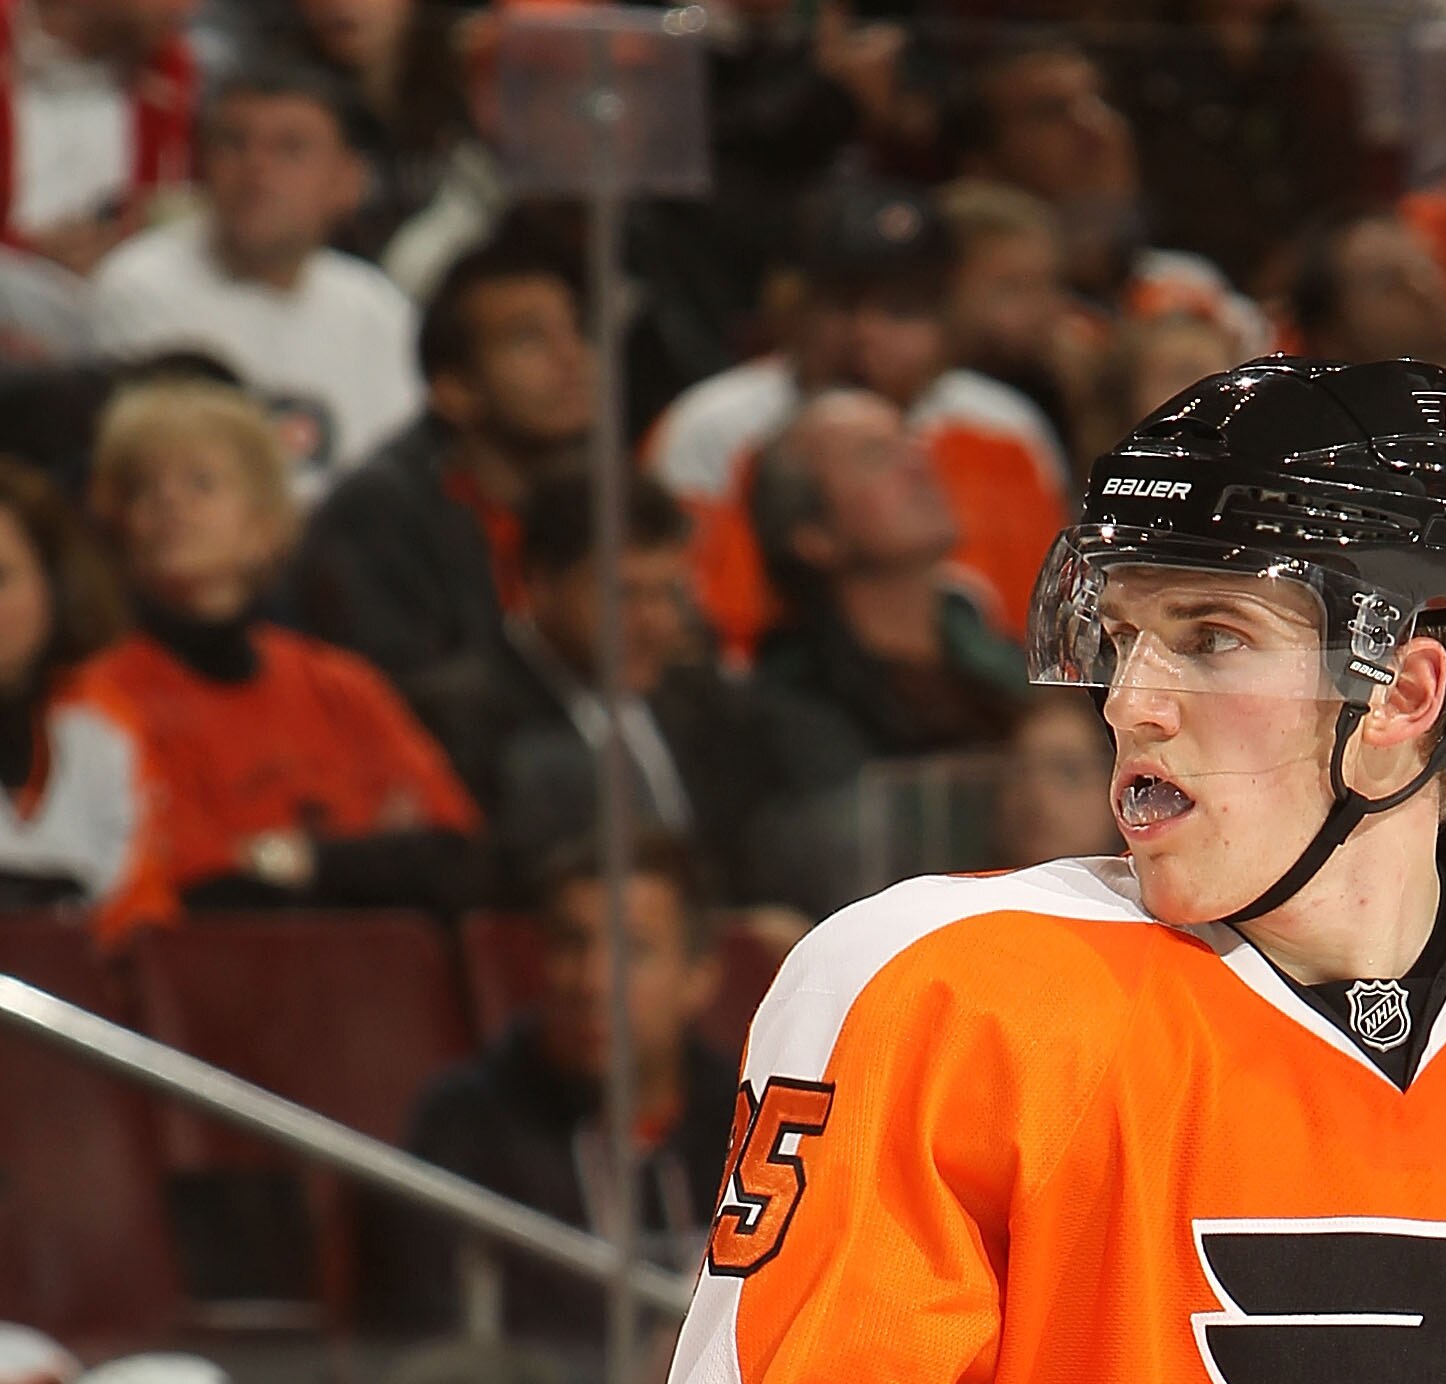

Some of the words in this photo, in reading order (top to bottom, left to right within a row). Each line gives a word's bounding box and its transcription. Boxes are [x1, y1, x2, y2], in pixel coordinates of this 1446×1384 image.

[1102, 477, 1192, 501] BAUER
[1349, 660, 1393, 684] BAUER
[1364, 999, 1399, 1035] NHL
